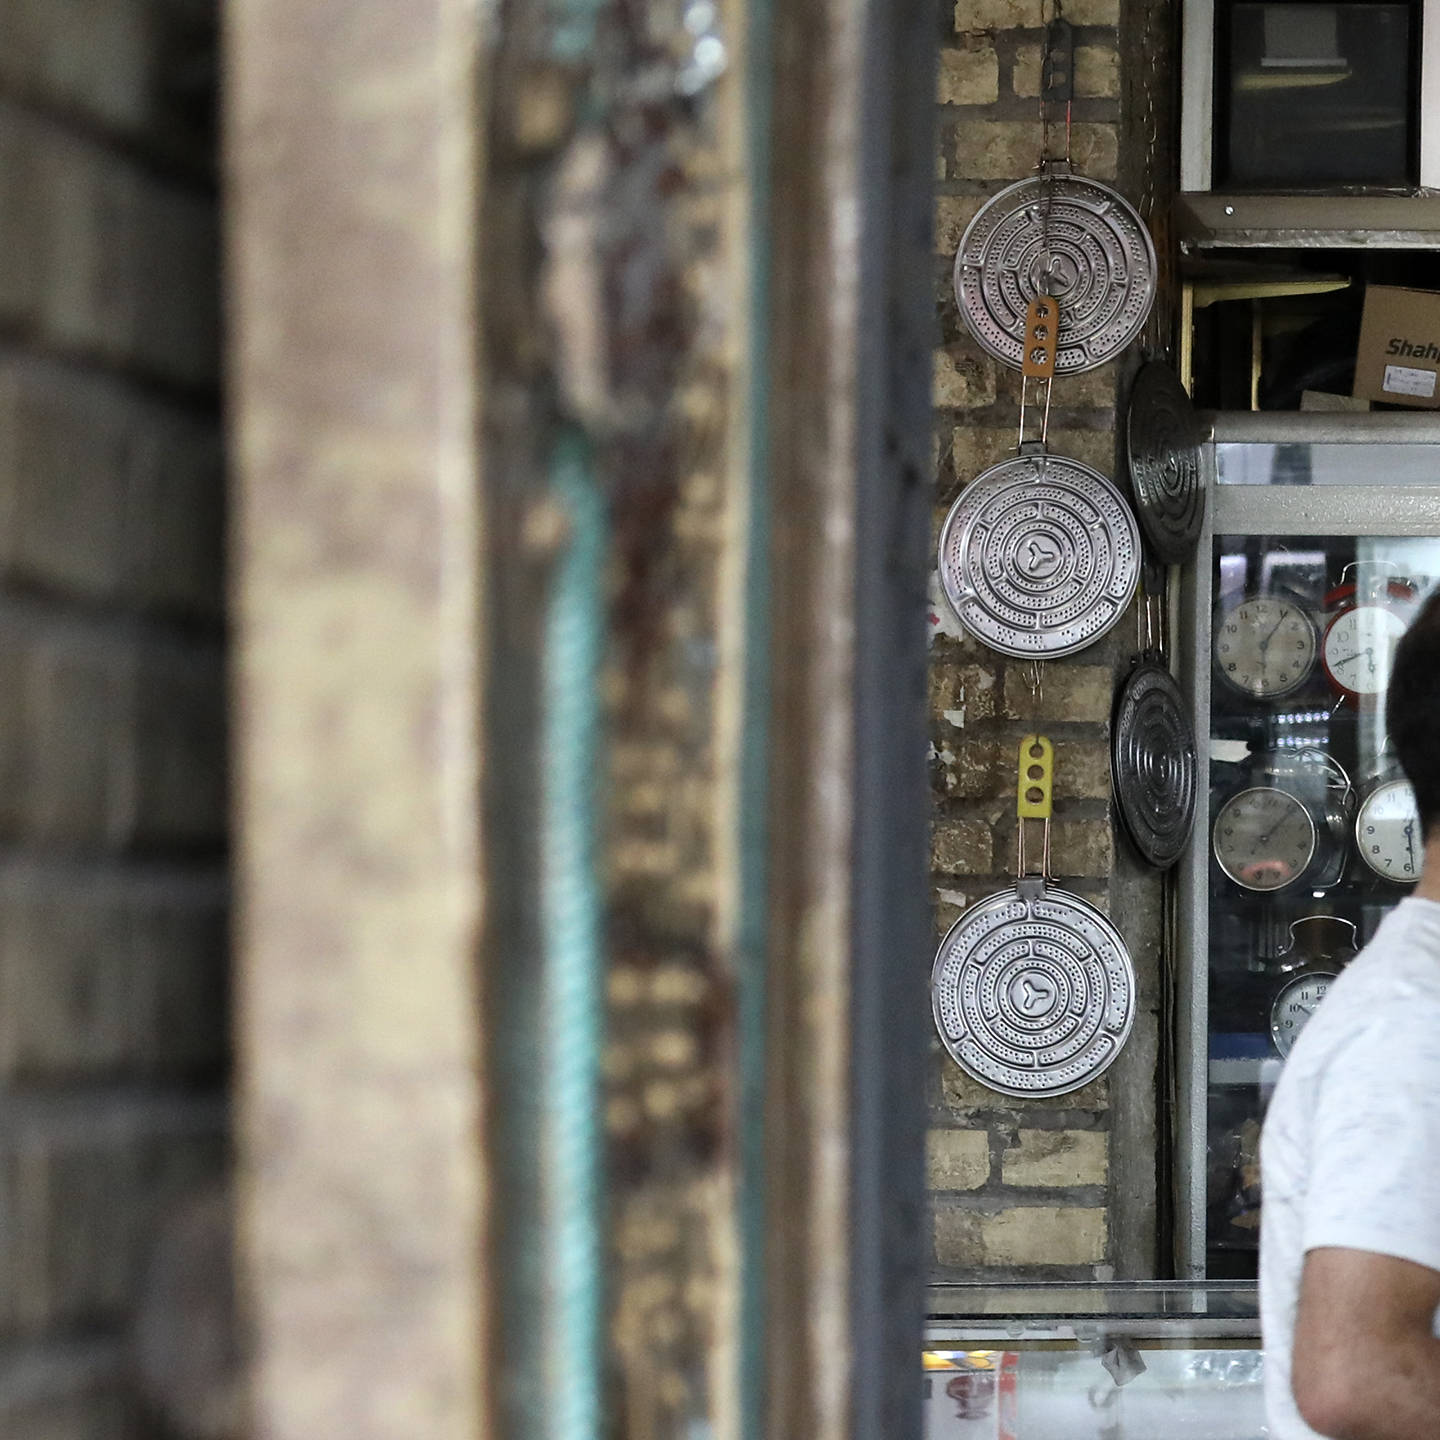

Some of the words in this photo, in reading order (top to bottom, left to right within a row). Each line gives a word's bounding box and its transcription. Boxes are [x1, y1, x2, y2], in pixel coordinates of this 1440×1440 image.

[1366, 825, 1375, 835] 9
[1372, 845, 1380, 854] 8
[1384, 859, 1392, 868] 7
